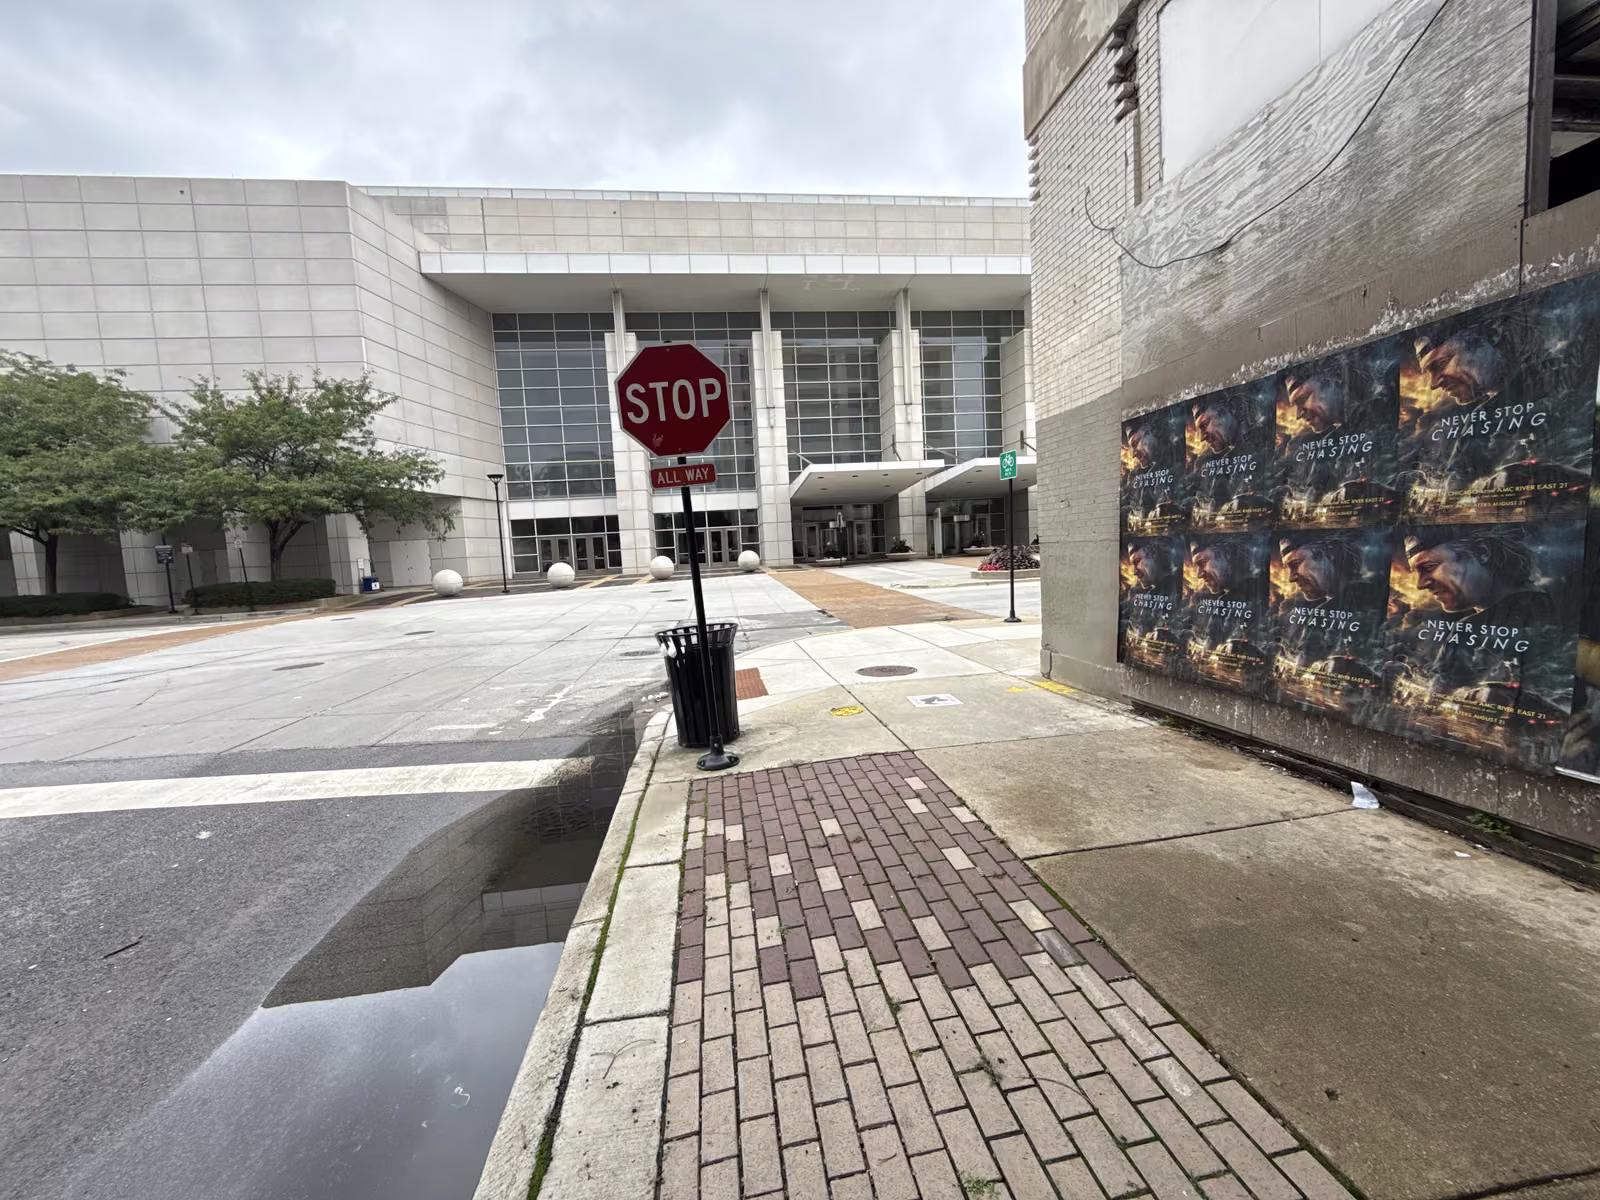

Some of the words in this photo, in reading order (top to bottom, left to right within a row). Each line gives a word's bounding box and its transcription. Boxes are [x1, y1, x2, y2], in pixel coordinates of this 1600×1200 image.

[625, 378, 721, 424] STOP
[1441, 410, 1487, 428] NEVER
[1494, 402, 1535, 418] STOP
[1431, 413, 1547, 441] CHASING
[1302, 438, 1334, 450] NEVER
[1338, 433, 1366, 445] STOP
[1296, 441, 1373, 462] CHASING
[1201, 461, 1257, 478] CHASING
[1206, 458, 1231, 469] NEVER
[1233, 454, 1253, 465] STOP
[657, 472, 681, 485] ALL
[685, 468, 709, 482] WAY
[1133, 475, 1174, 489] CHASING
[1135, 471, 1153, 482] NEVER
[1154, 468, 1170, 478] STOP
[1497, 486, 1514, 494] AMC
[1515, 484, 1535, 492] RIVER
[1537, 482, 1558, 490] EAST
[1133, 599, 1173, 611] CHASING
[1135, 593, 1152, 601] NEVER
[1153, 594, 1169, 602] STOP
[1202, 599, 1225, 608] NEVER
[1227, 600, 1247, 609] STOP
[1198, 605, 1253, 619] CHASING
[1294, 607, 1326, 618] NEVER
[1329, 609, 1353, 620] STOP
[1289, 614, 1360, 632] CHASING
[1427, 619, 1473, 633] NEVER
[1480, 624, 1519, 638] STOP
[1417, 629, 1531, 653] CHASING
[1497, 704, 1515, 713] RIVER
[1517, 708, 1536, 717] EAST
[1537, 712, 1547, 720] 21
